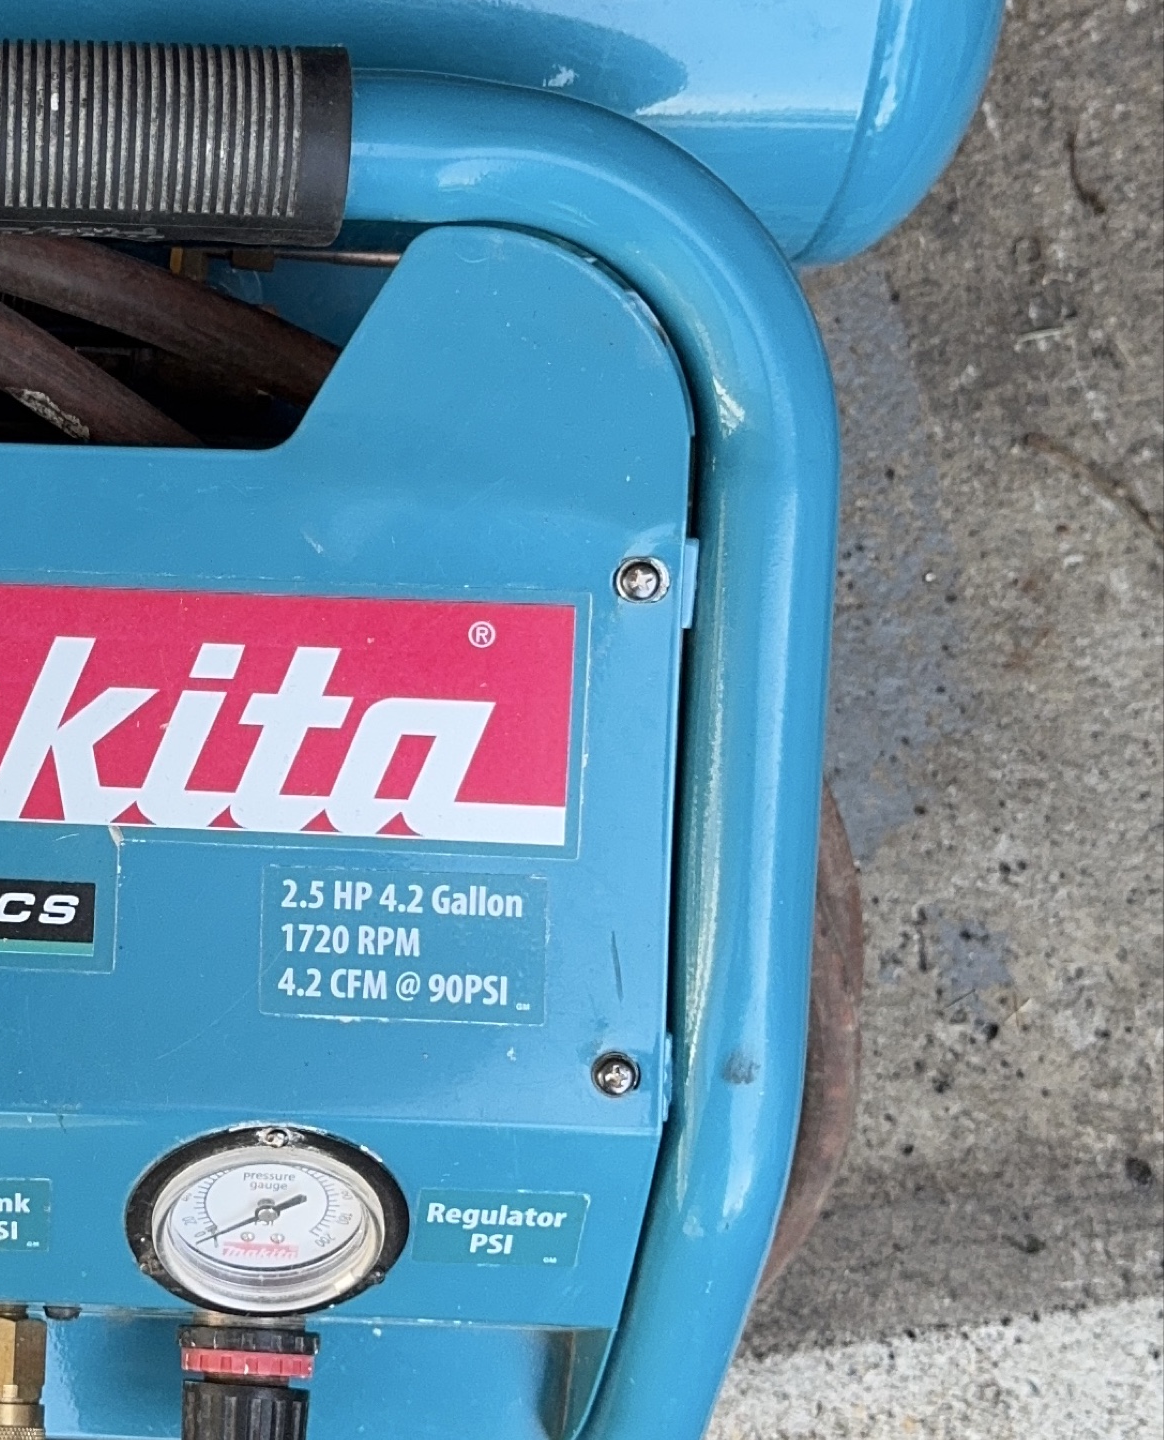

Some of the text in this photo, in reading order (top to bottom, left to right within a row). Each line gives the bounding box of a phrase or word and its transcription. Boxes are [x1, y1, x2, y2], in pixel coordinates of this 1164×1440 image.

[280, 879, 523, 918] 2.5 HP 4.2 Gallon
[281, 923, 420, 957] 1720 RPM
[277, 967, 508, 1006] 4.2 CFM @ 90PSI
[243, 1171, 296, 1182] pressure
[249, 1180, 288, 1191] gauge
[426, 1202, 568, 1230] Regulator
[469, 1233, 514, 1255] PSI
